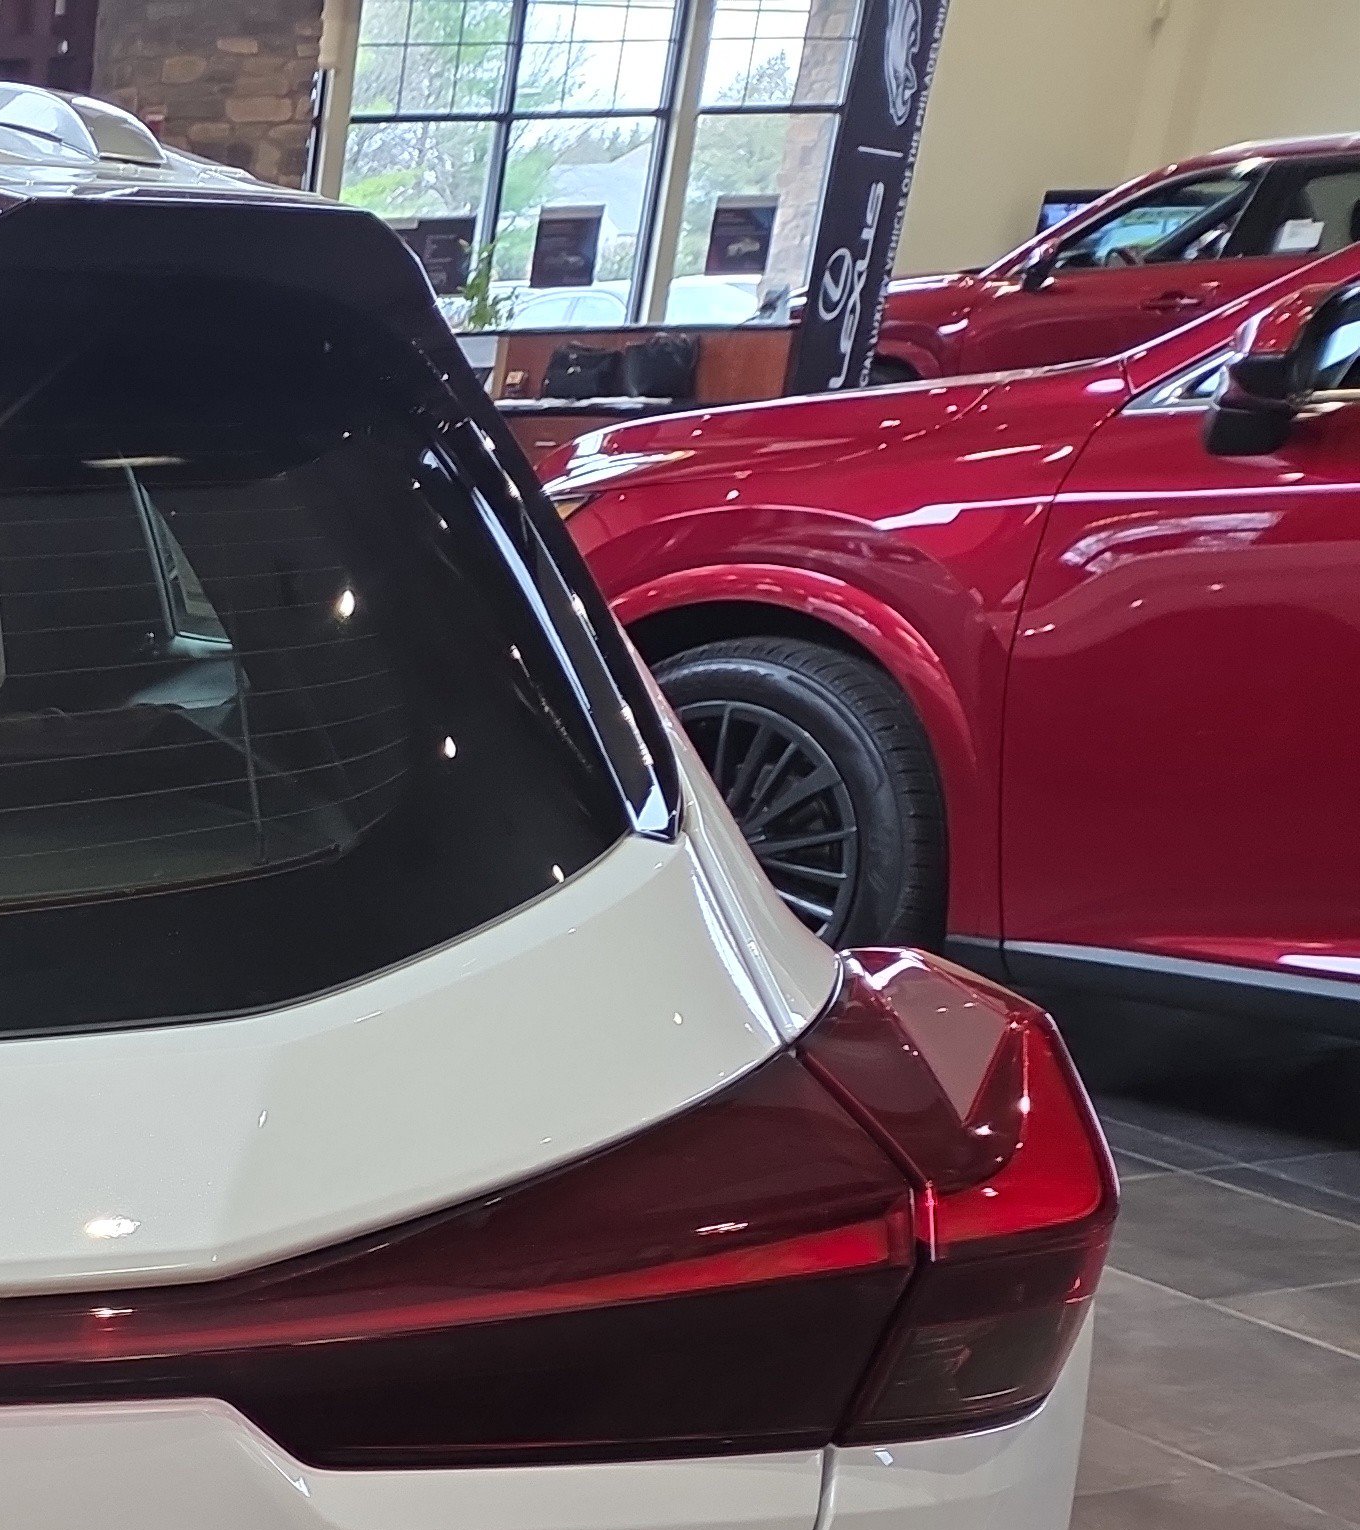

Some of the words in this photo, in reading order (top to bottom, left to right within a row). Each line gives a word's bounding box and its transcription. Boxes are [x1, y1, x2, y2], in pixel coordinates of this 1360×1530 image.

[828, 181, 885, 389] LEXUS
[884, 199, 908, 271] VEHICLE
[901, 169, 913, 193] OF
[907, 132, 921, 163] THE
